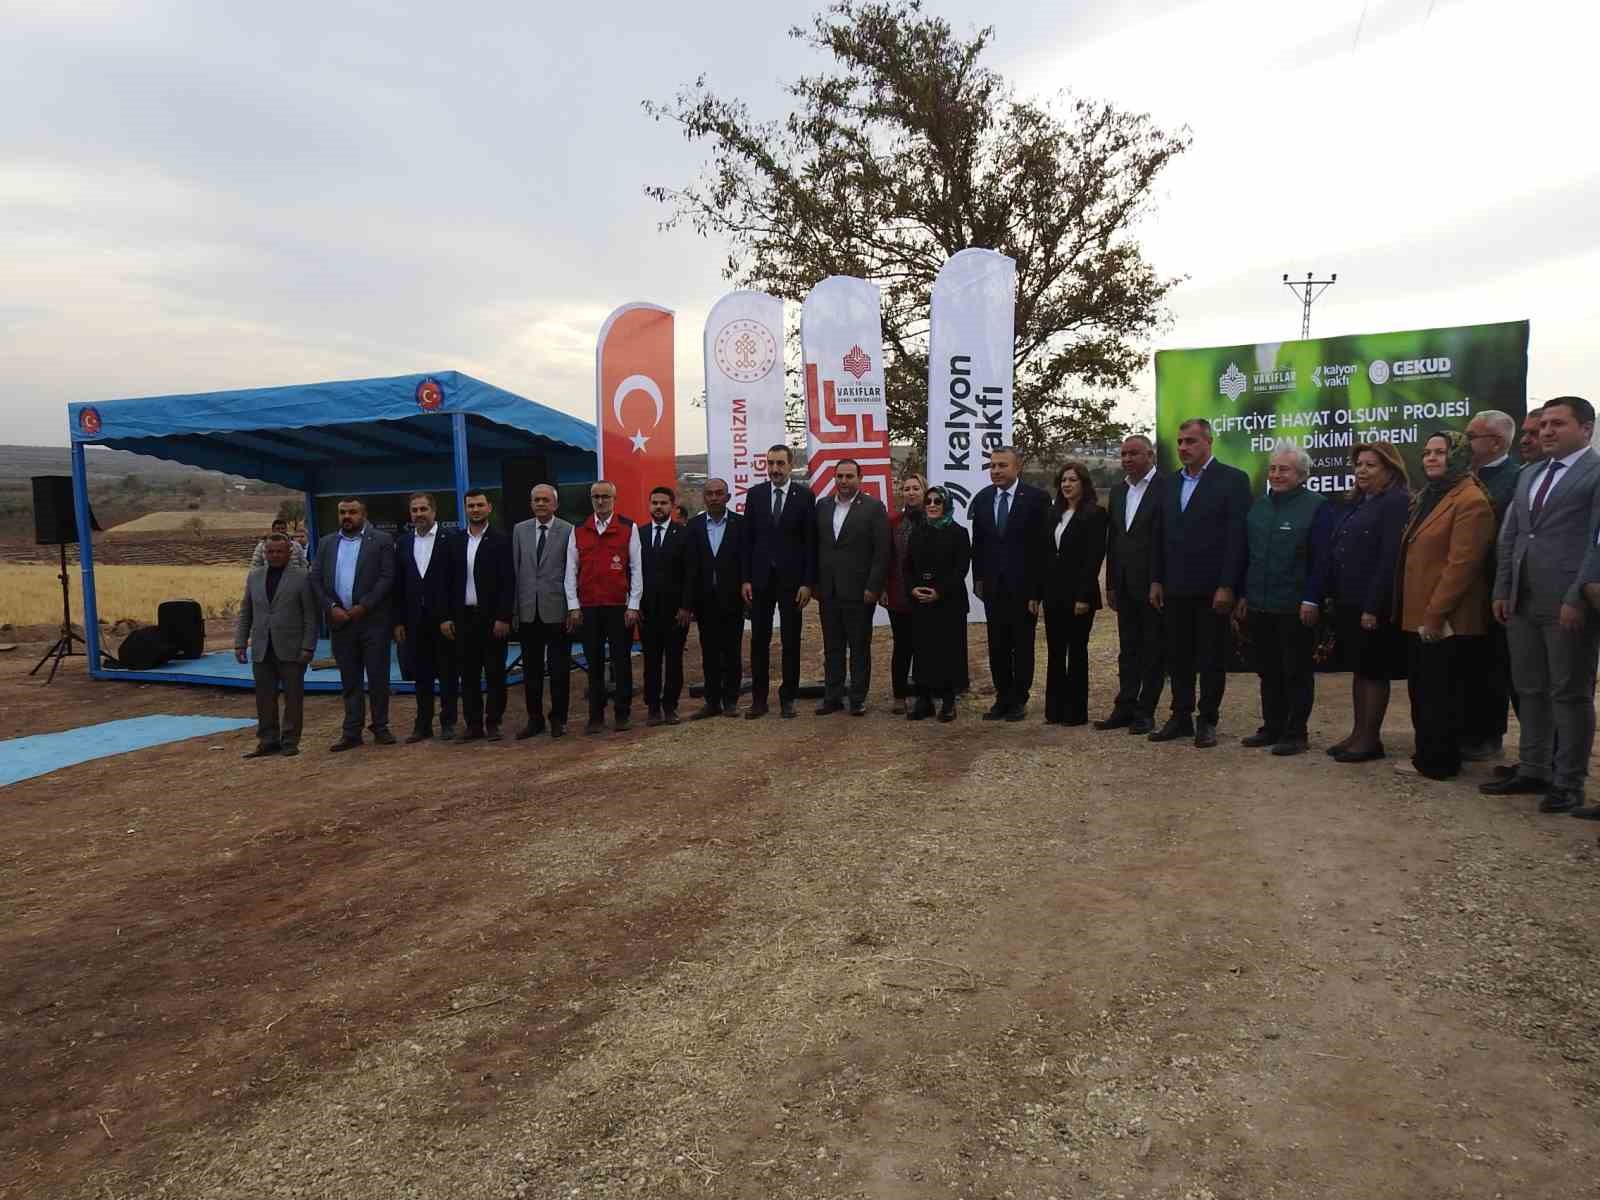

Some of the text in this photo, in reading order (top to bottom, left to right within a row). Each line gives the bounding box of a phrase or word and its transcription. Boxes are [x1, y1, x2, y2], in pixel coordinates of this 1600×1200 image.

[837, 386, 881, 397] VAKIFLAR
[944, 355, 978, 471] kalyon
[1282, 410, 1331, 429] HAYAT
[1335, 405, 1398, 425] OLSUN"
[1403, 397, 1470, 420] PROJESİ
[730, 399, 748, 469] TURİZM
[1303, 428, 1353, 449] DİKİMİ
[1358, 424, 1418, 444] TÖRENİ
[734, 474, 749, 496] VE
[1306, 474, 1357, 492] GELD
